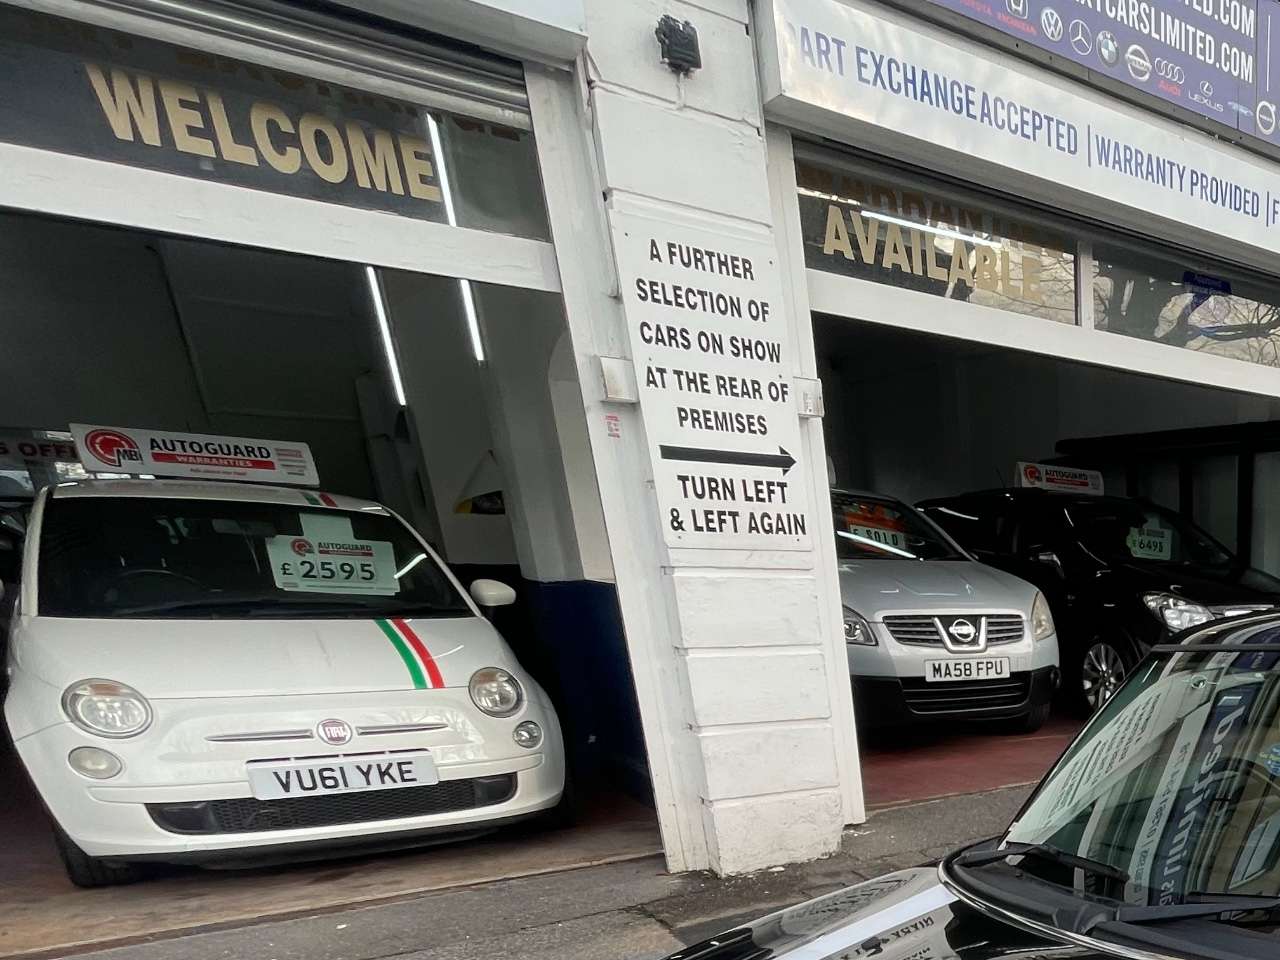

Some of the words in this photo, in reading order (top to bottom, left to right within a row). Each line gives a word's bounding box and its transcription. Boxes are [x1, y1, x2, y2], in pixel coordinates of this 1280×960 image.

[85, 63, 444, 203] WELCOME
[855, 46, 977, 121] EXCHANGE
[980, 96, 1078, 156] ACCEPTED
[1095, 134, 1186, 194] WARRANTY
[1190, 166, 1260, 218] PROVIDED
[649, 238, 663, 263] A
[667, 242, 754, 281] FURTHER
[823, 204, 1042, 300] AVAILABLE
[636, 278, 742, 318] SELECTION
[748, 298, 770, 323] OF
[640, 321, 691, 350] CARS
[697, 330, 724, 356] ON
[729, 336, 781, 363] SHOW
[645, 365, 667, 389] AT
[673, 369, 709, 395] THE
[716, 374, 763, 401] REAR
[768, 382, 789, 403] OF
[677, 406, 768, 436] PREMISES
[150, 437, 271, 459] AUTOGUARD
[175, 455, 254, 468] WARRANTIES
[677, 475, 735, 501] TURN
[741, 479, 788, 504] LEFT
[670, 507, 685, 532] &
[691, 508, 740, 534] LEFT
[748, 511, 807, 536] AGAIN
[318, 542, 372, 551] AUTOGUARD
[932, 662, 973, 679] MA58
[976, 660, 1003, 677] FPU
[324, 725, 348, 738] FIAT
[272, 765, 349, 794] VU61
[355, 760, 418, 786] YKE
